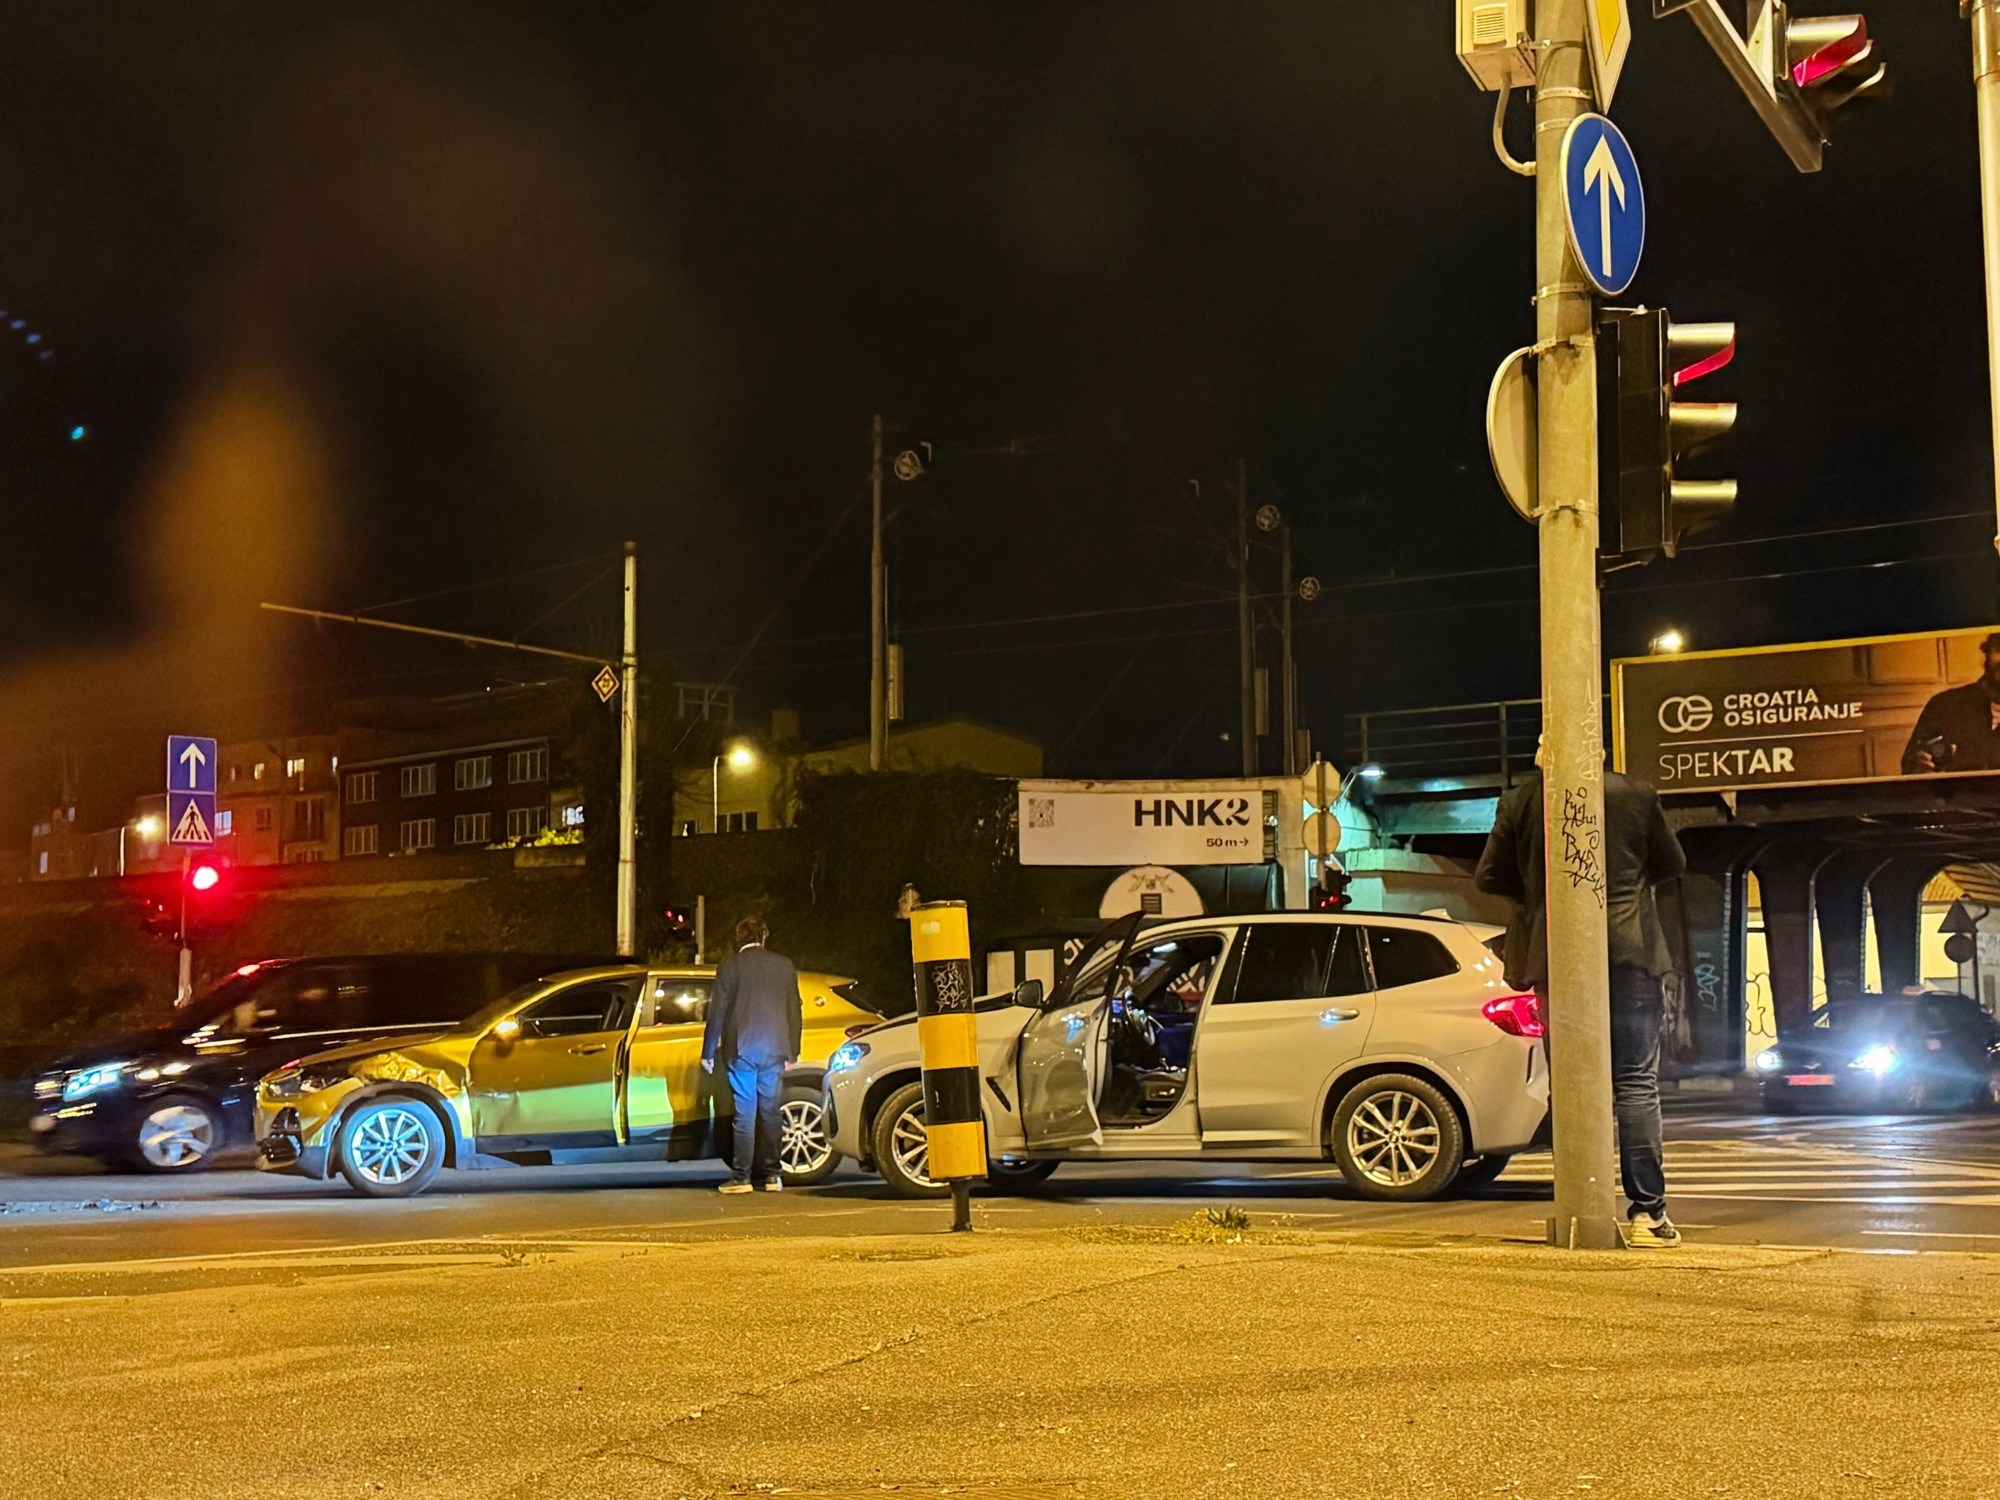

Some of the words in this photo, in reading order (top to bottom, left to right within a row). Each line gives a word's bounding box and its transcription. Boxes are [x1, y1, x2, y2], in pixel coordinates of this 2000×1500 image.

[1724, 688, 1818, 710] CROATIA
[1724, 702, 1863, 727] OSIGURANJE
[1659, 747, 1794, 780] SPEKTAR
[1135, 798, 1250, 827] HNK2
[1206, 838, 1222, 847] 50
[1225, 839, 1237, 847] m
